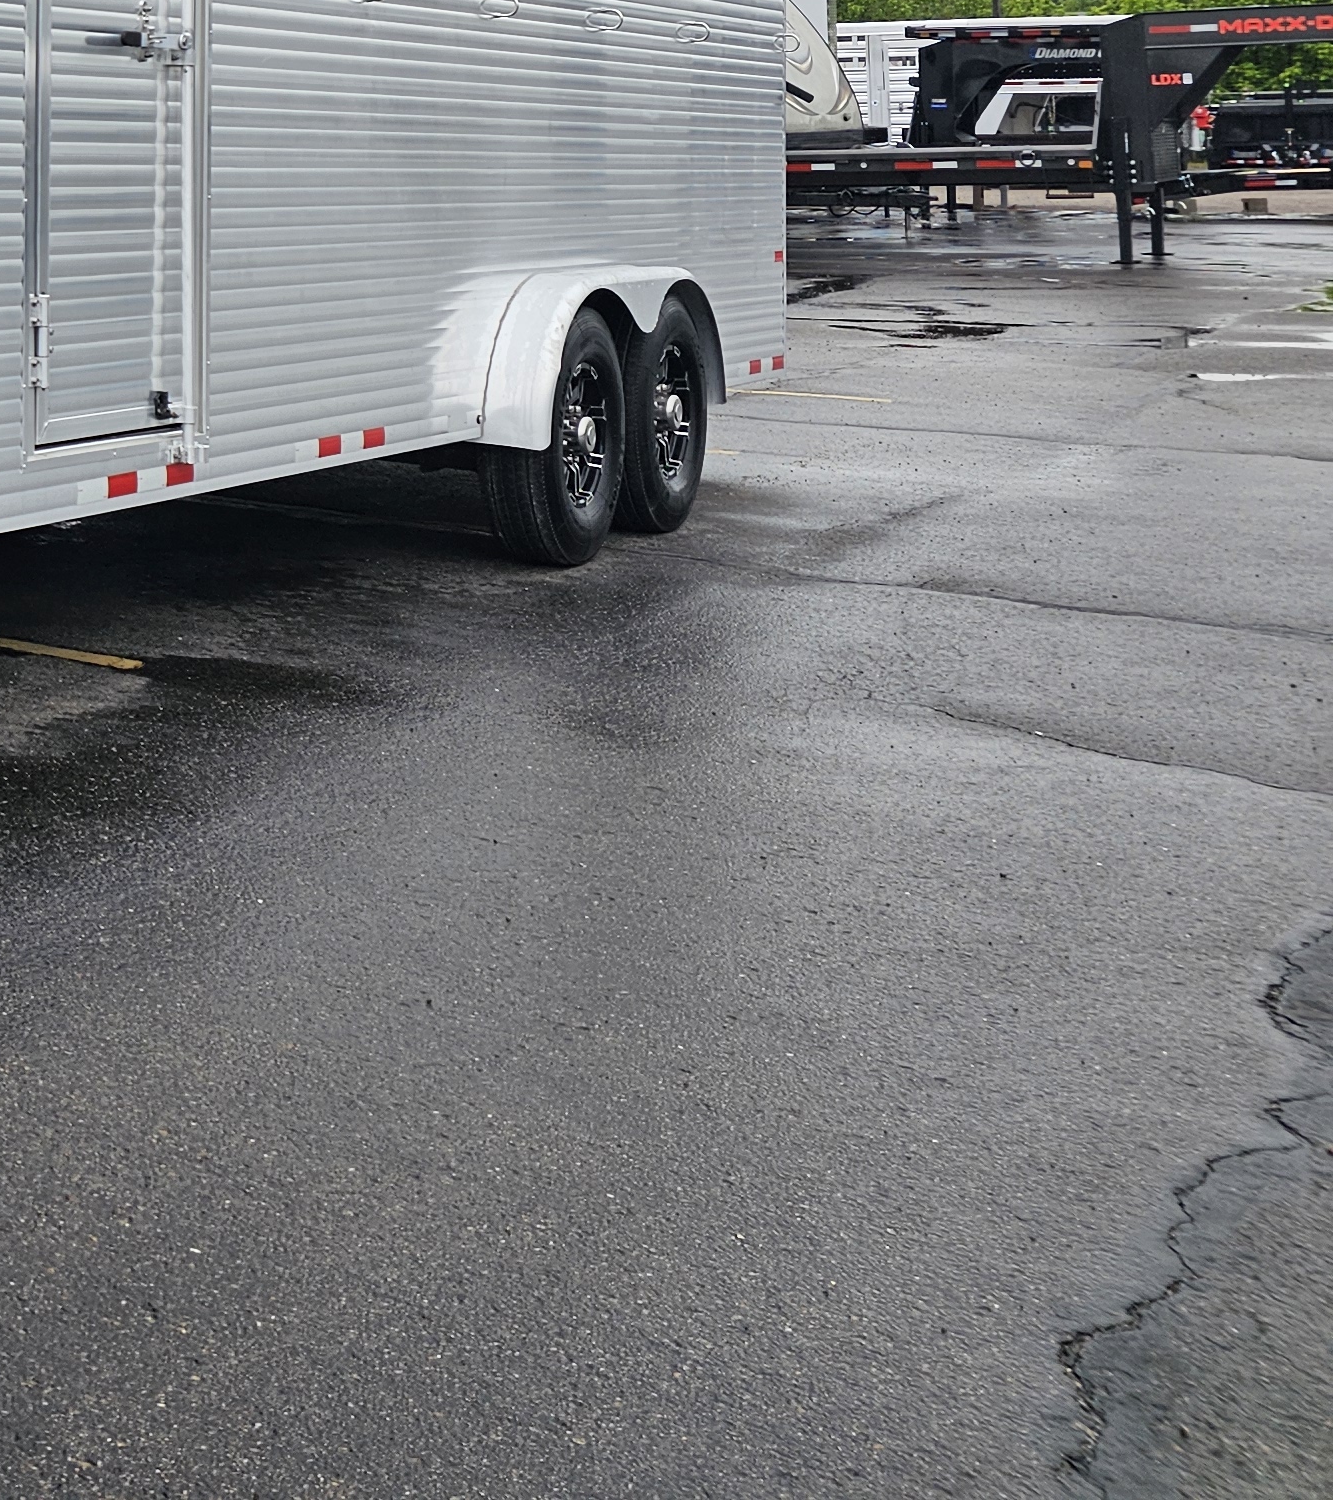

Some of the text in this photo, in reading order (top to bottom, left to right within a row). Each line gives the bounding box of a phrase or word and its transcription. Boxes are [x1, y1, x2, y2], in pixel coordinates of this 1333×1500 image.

[1218, 14, 1333, 35] MAXX-D
[1034, 47, 1096, 59] DIAMOND
[1150, 73, 1182, 86] LDX
